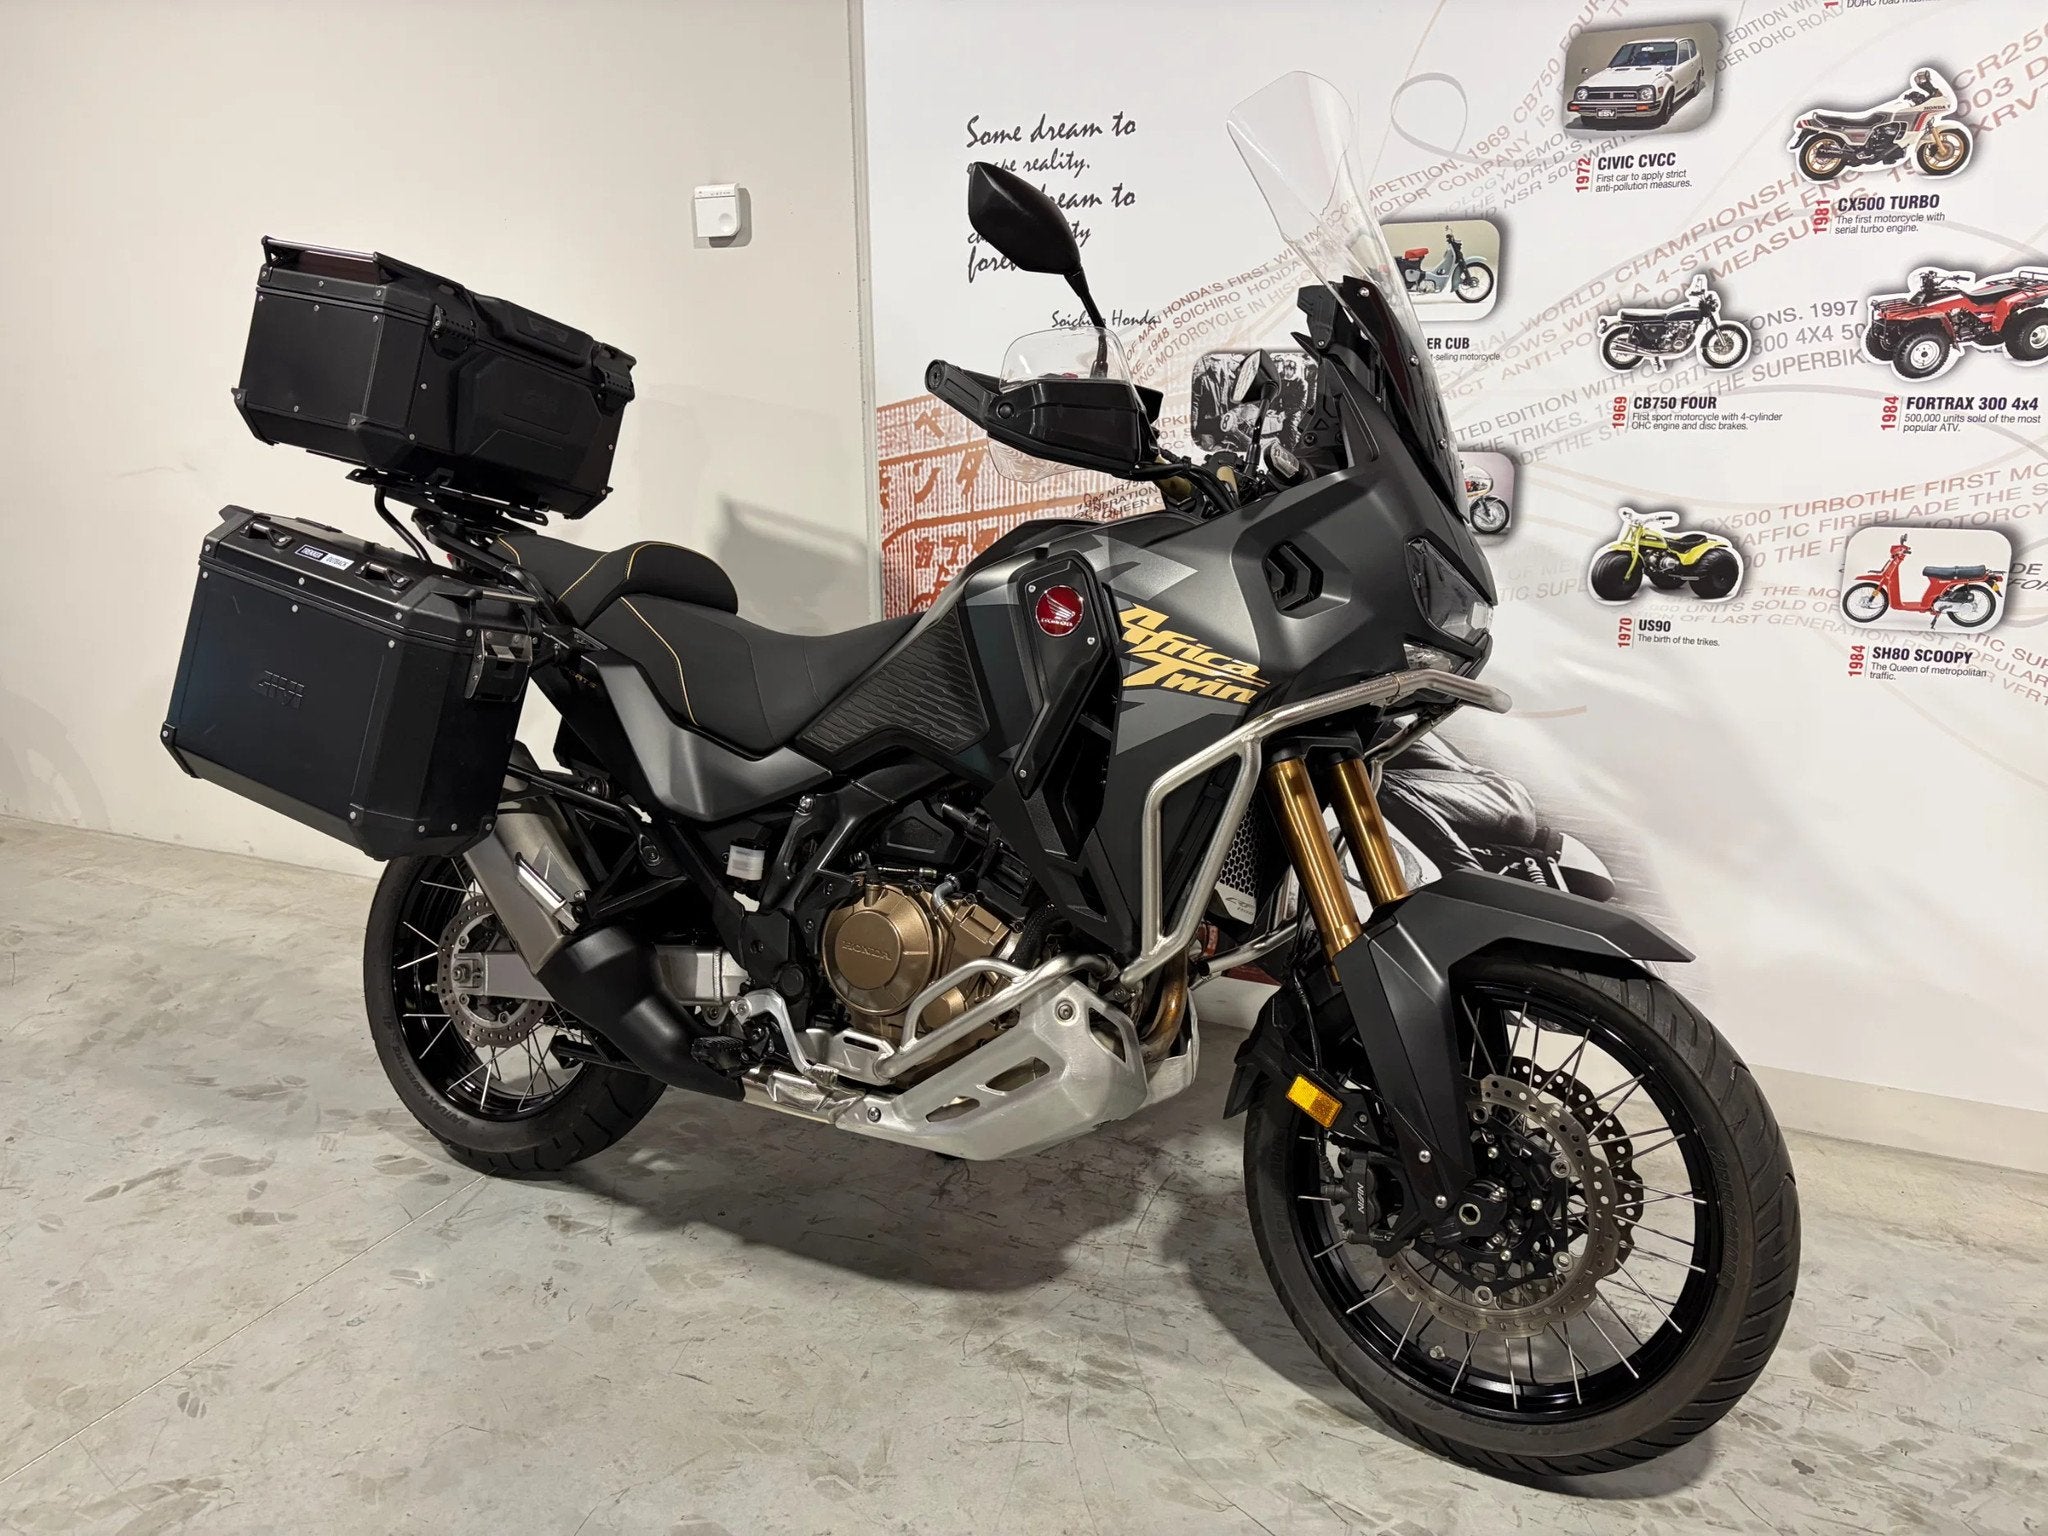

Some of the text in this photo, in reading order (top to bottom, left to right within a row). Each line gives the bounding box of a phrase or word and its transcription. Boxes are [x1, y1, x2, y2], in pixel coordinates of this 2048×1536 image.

[1725, 8, 1790, 47] EDITION
[1749, 25, 1798, 57] DOHC
[1799, 5, 1846, 33] ROAD
[966, 111, 1137, 148] Some dream to
[1022, 147, 1091, 179] reality.
[1501, 139, 1583, 196] WORLD'S
[1575, 157, 1592, 193] 1972
[1597, 152, 1677, 172] CIVIC CVCC
[1163, 282, 1225, 319] HONDA'S
[1227, 262, 1271, 287] FIRST
[1466, 125, 1512, 161] 1969
[1512, 56, 1562, 127] CB750
[1595, 179, 1693, 194] anti-pollution measures.
[1596, 169, 1688, 183] First car to apply strict
[1111, 182, 1137, 208] to
[1502, 181, 1543, 210] NSR
[1837, 193, 1941, 212] CX500 TURBO
[1812, 199, 1831, 235] 1981
[1834, 223, 1920, 236] serial turbo engine.
[1836, 211, 1946, 225] The first motorcycle with
[1173, 290, 1241, 332] SOICHIRO
[1438, 129, 1530, 193] COMPANY
[1562, 291, 1626, 334] WITH
[1655, 200, 1794, 284] 4-STROKE
[1111, 309, 1158, 328] Honda
[1520, 279, 1607, 333] WORLD
[1809, 299, 1860, 320] 1997
[1155, 303, 1247, 366] MOTORCYCLE
[1444, 336, 1471, 350] CUB
[1794, 324, 1835, 346] 4X4
[1459, 352, 1501, 362] motorcycle
[1752, 348, 1871, 383] SUPERBIK
[1494, 389, 1580, 430] EDITION
[1581, 370, 1636, 403] WITH
[1611, 396, 1628, 430] 1969
[1633, 396, 1718, 410] CB750 FOUR
[1906, 396, 2040, 411] FORTRAX 300 4x4
[1631, 421, 1749, 432] OHC engine and disc brakes.
[1632, 411, 1783, 423] First sport motorcycle with 4-cylinder
[1881, 396, 1900, 431] 1984
[1904, 413, 2042, 424] 500,000 units sold of the most
[1508, 412, 1588, 446] TRIKES.
[1903, 423, 1962, 435] popular ATV.
[1550, 430, 1593, 456] THE
[1778, 483, 1917, 521] TURBOTHE
[1924, 470, 2002, 498] FIRST
[1816, 496, 1961, 534] FIREBLADE
[1968, 486, 2024, 508] THE
[1773, 538, 1826, 565] THE
[1761, 586, 1801, 598] THE
[1750, 599, 1807, 612] SOLD
[1617, 617, 1633, 648] 1970
[1638, 619, 1672, 633] US90
[1710, 614, 1765, 625] LAST
[1119, 602, 1268, 684] Africa
[1637, 634, 1721, 647] The birth of the trikes.
[1848, 645, 1866, 678] 1984
[1872, 646, 1974, 665] SH80 SCOOPY
[1122, 651, 1266, 705] Twin
[1869, 671, 1897, 681] traffic.
[1871, 662, 1888, 671] The
[1889, 663, 1919, 675] Queen
[1920, 664, 1931, 674] of
[1931, 666, 1987, 679] metropolitan
[841, 940, 893, 961] HONDA
